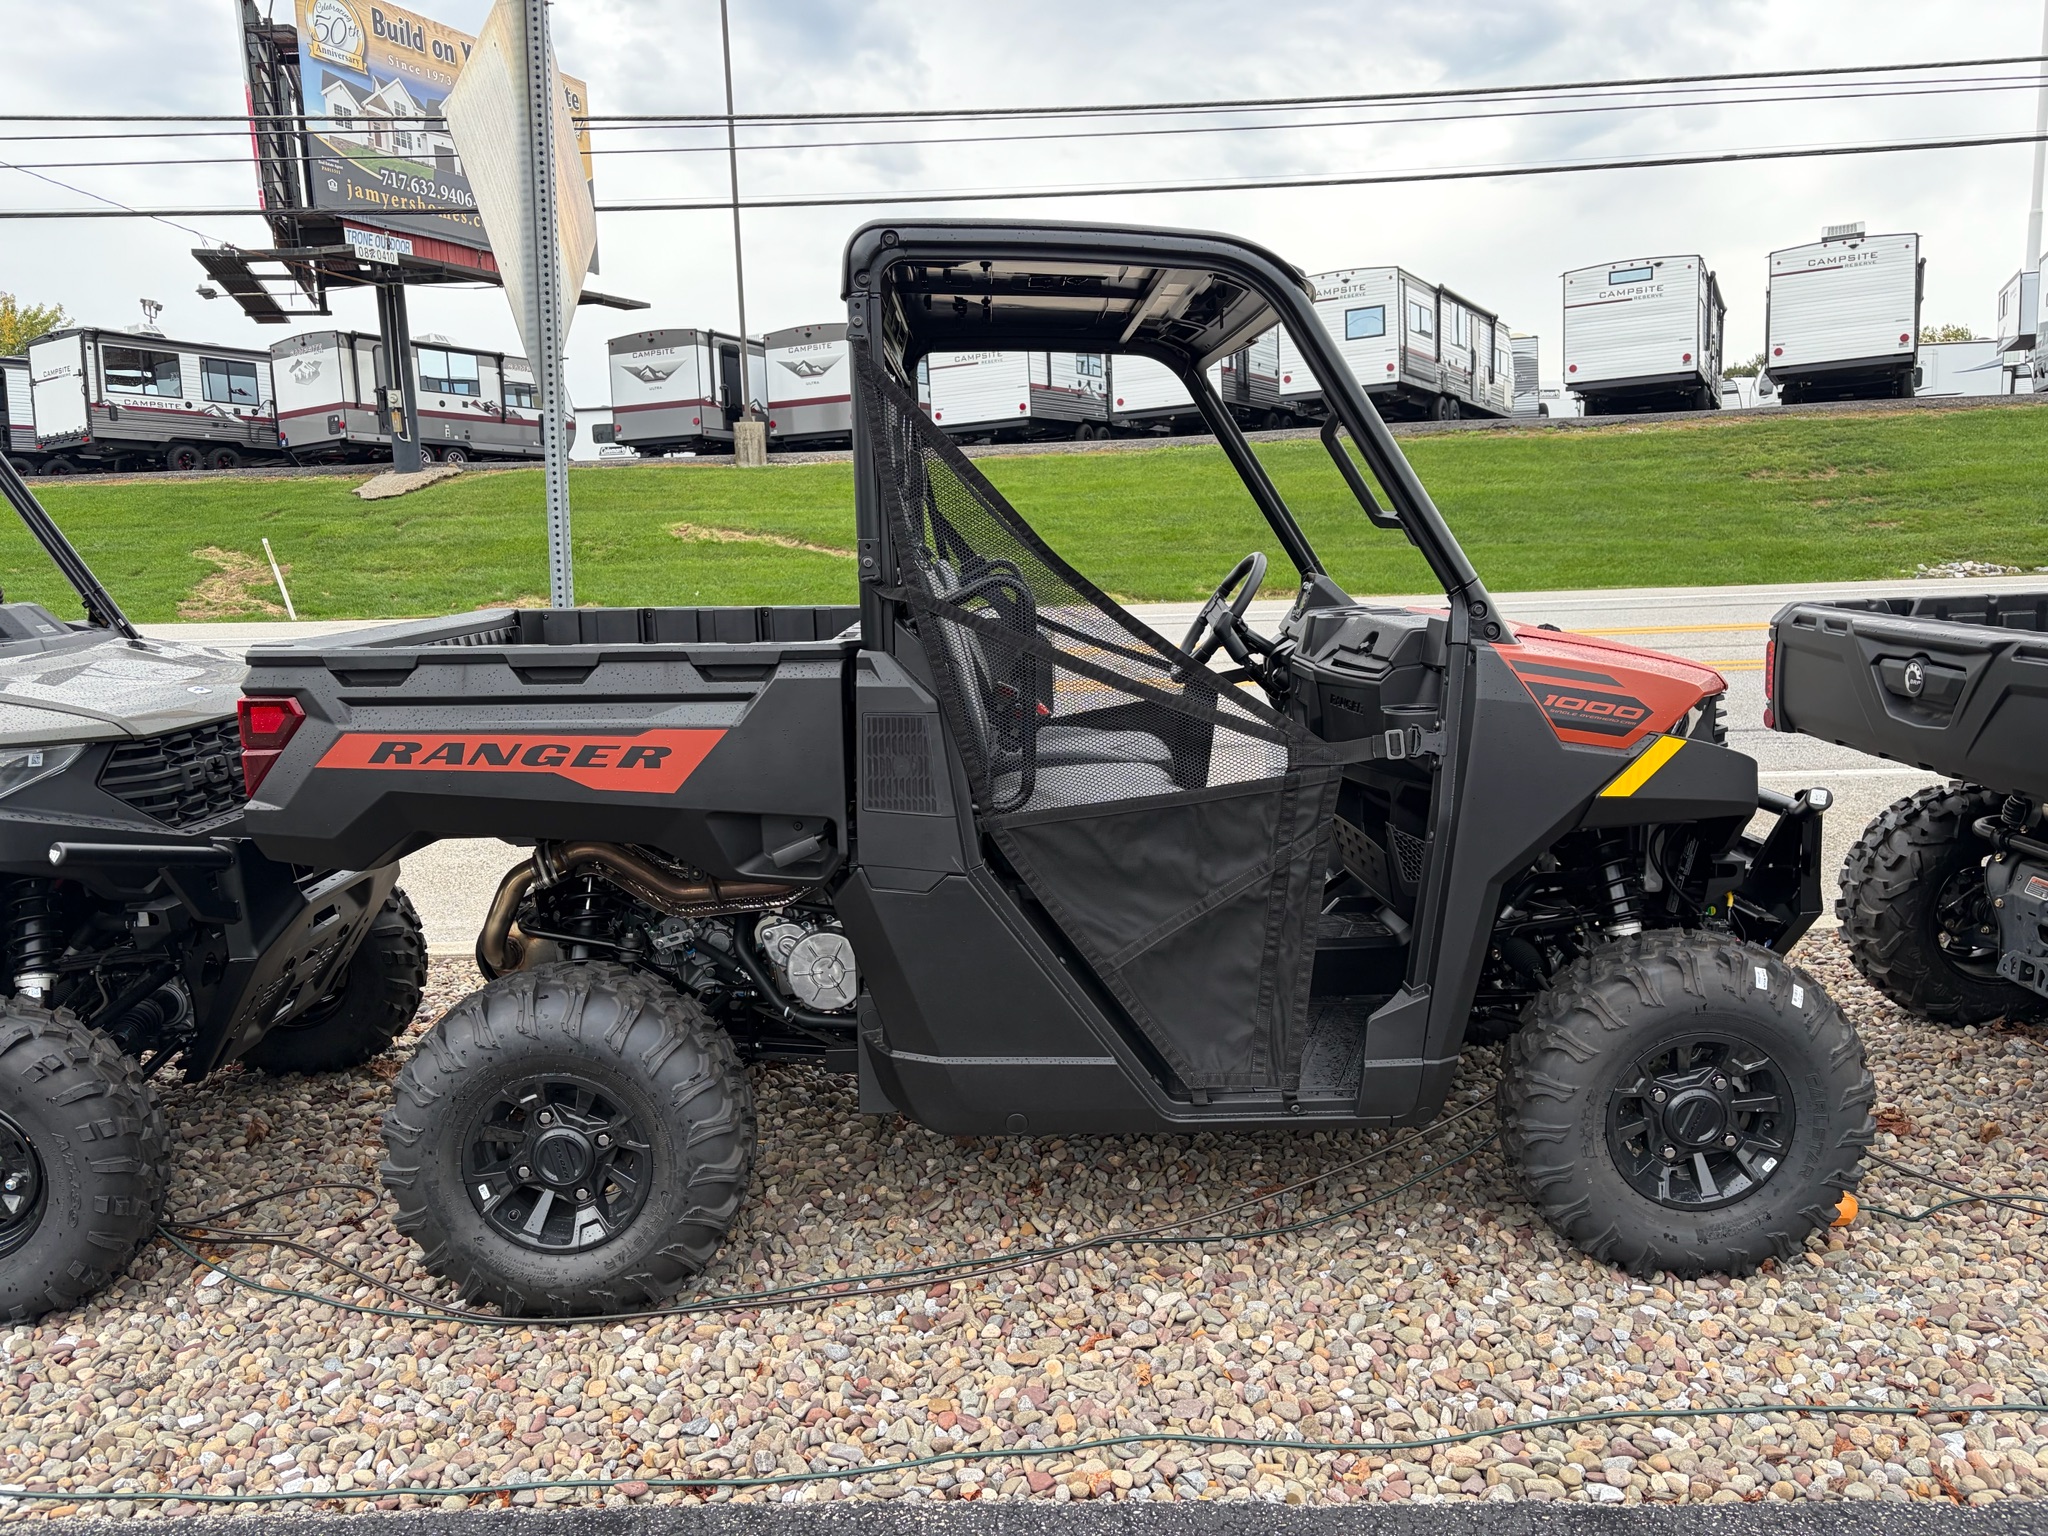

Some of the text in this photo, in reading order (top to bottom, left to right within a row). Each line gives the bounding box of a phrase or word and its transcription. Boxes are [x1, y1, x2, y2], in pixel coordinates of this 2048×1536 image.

[316, 1, 352, 22] Celebrating
[311, 15, 361, 45] 50th
[371, 6, 425, 53] Build
[432, 39, 456, 64] on
[316, 44, 361, 69] Anniversary
[388, 55, 453, 86] Since 1973
[565, 86, 580, 110] te
[346, 178, 485, 227] jamyershomes.c
[346, 229, 373, 247] TRONE
[1807, 251, 1879, 267] CAMPSITE
[1844, 259, 1877, 268] RESERVE
[1316, 283, 1367, 297] AMPSITE
[1598, 285, 1664, 299] CAMPSITE
[1633, 293, 1664, 301] RESERVE
[632, 347, 676, 359] CAMPSITE
[788, 342, 833, 354] CAMPSITE
[954, 351, 1003, 363] CAMPSITE
[43, 365, 71, 378] CAMPSITE
[124, 398, 182, 410] CAMPSITE
[1543, 694, 1646, 720] 1000
[1549, 708, 1578, 717] SINGLE
[367, 741, 673, 769] RANGER
